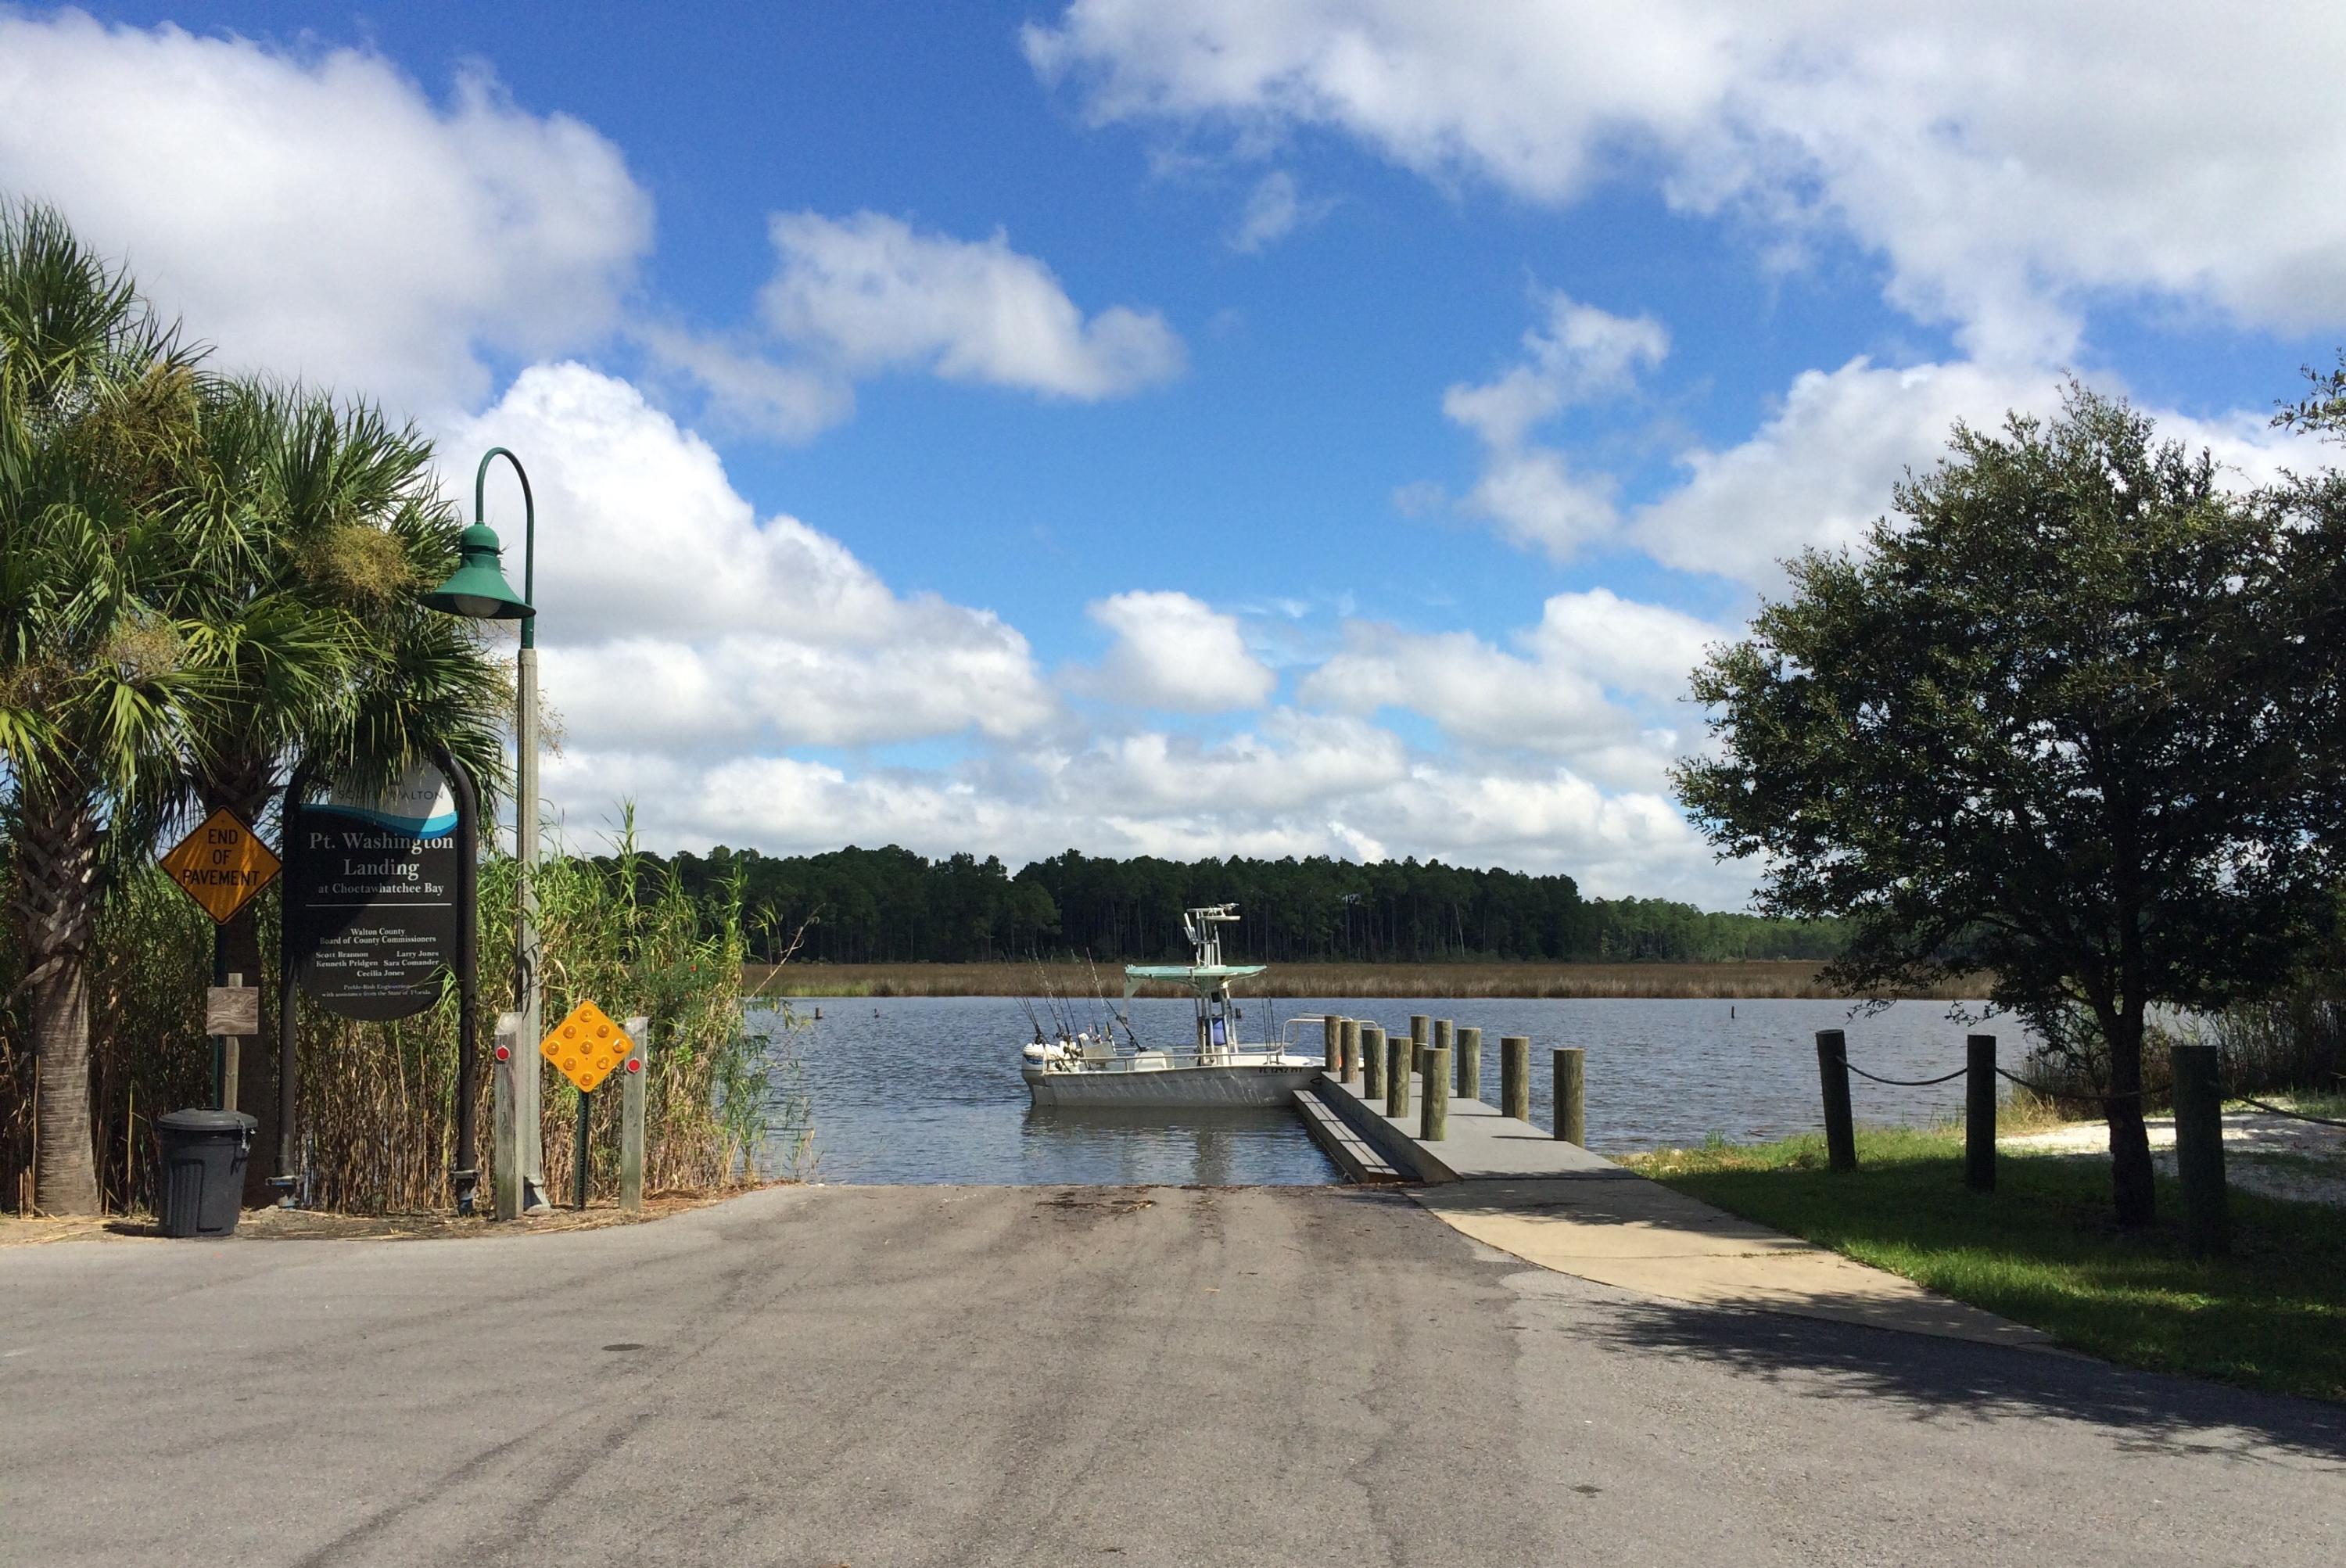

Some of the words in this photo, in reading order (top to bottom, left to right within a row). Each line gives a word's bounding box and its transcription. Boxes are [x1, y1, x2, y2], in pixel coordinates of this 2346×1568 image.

[208, 829, 238, 845] END
[309, 833, 335, 849] Pt.
[343, 832, 454, 855] Washington
[213, 849, 232, 865] OF
[182, 869, 260, 886] PAVEMENT
[343, 859, 420, 881] Landing
[318, 884, 328, 894] at
[332, 882, 421, 894] Choctawhatchee
[424, 882, 444, 896] Bay
[320, 936, 341, 945] Board
[343, 936, 351, 945] of
[353, 936, 380, 945] County
[382, 935, 436, 944] Commissioners
[379, 928, 406, 937] County
[396, 950, 416, 959] Larry
[349, 960, 378, 968] Pridgen
